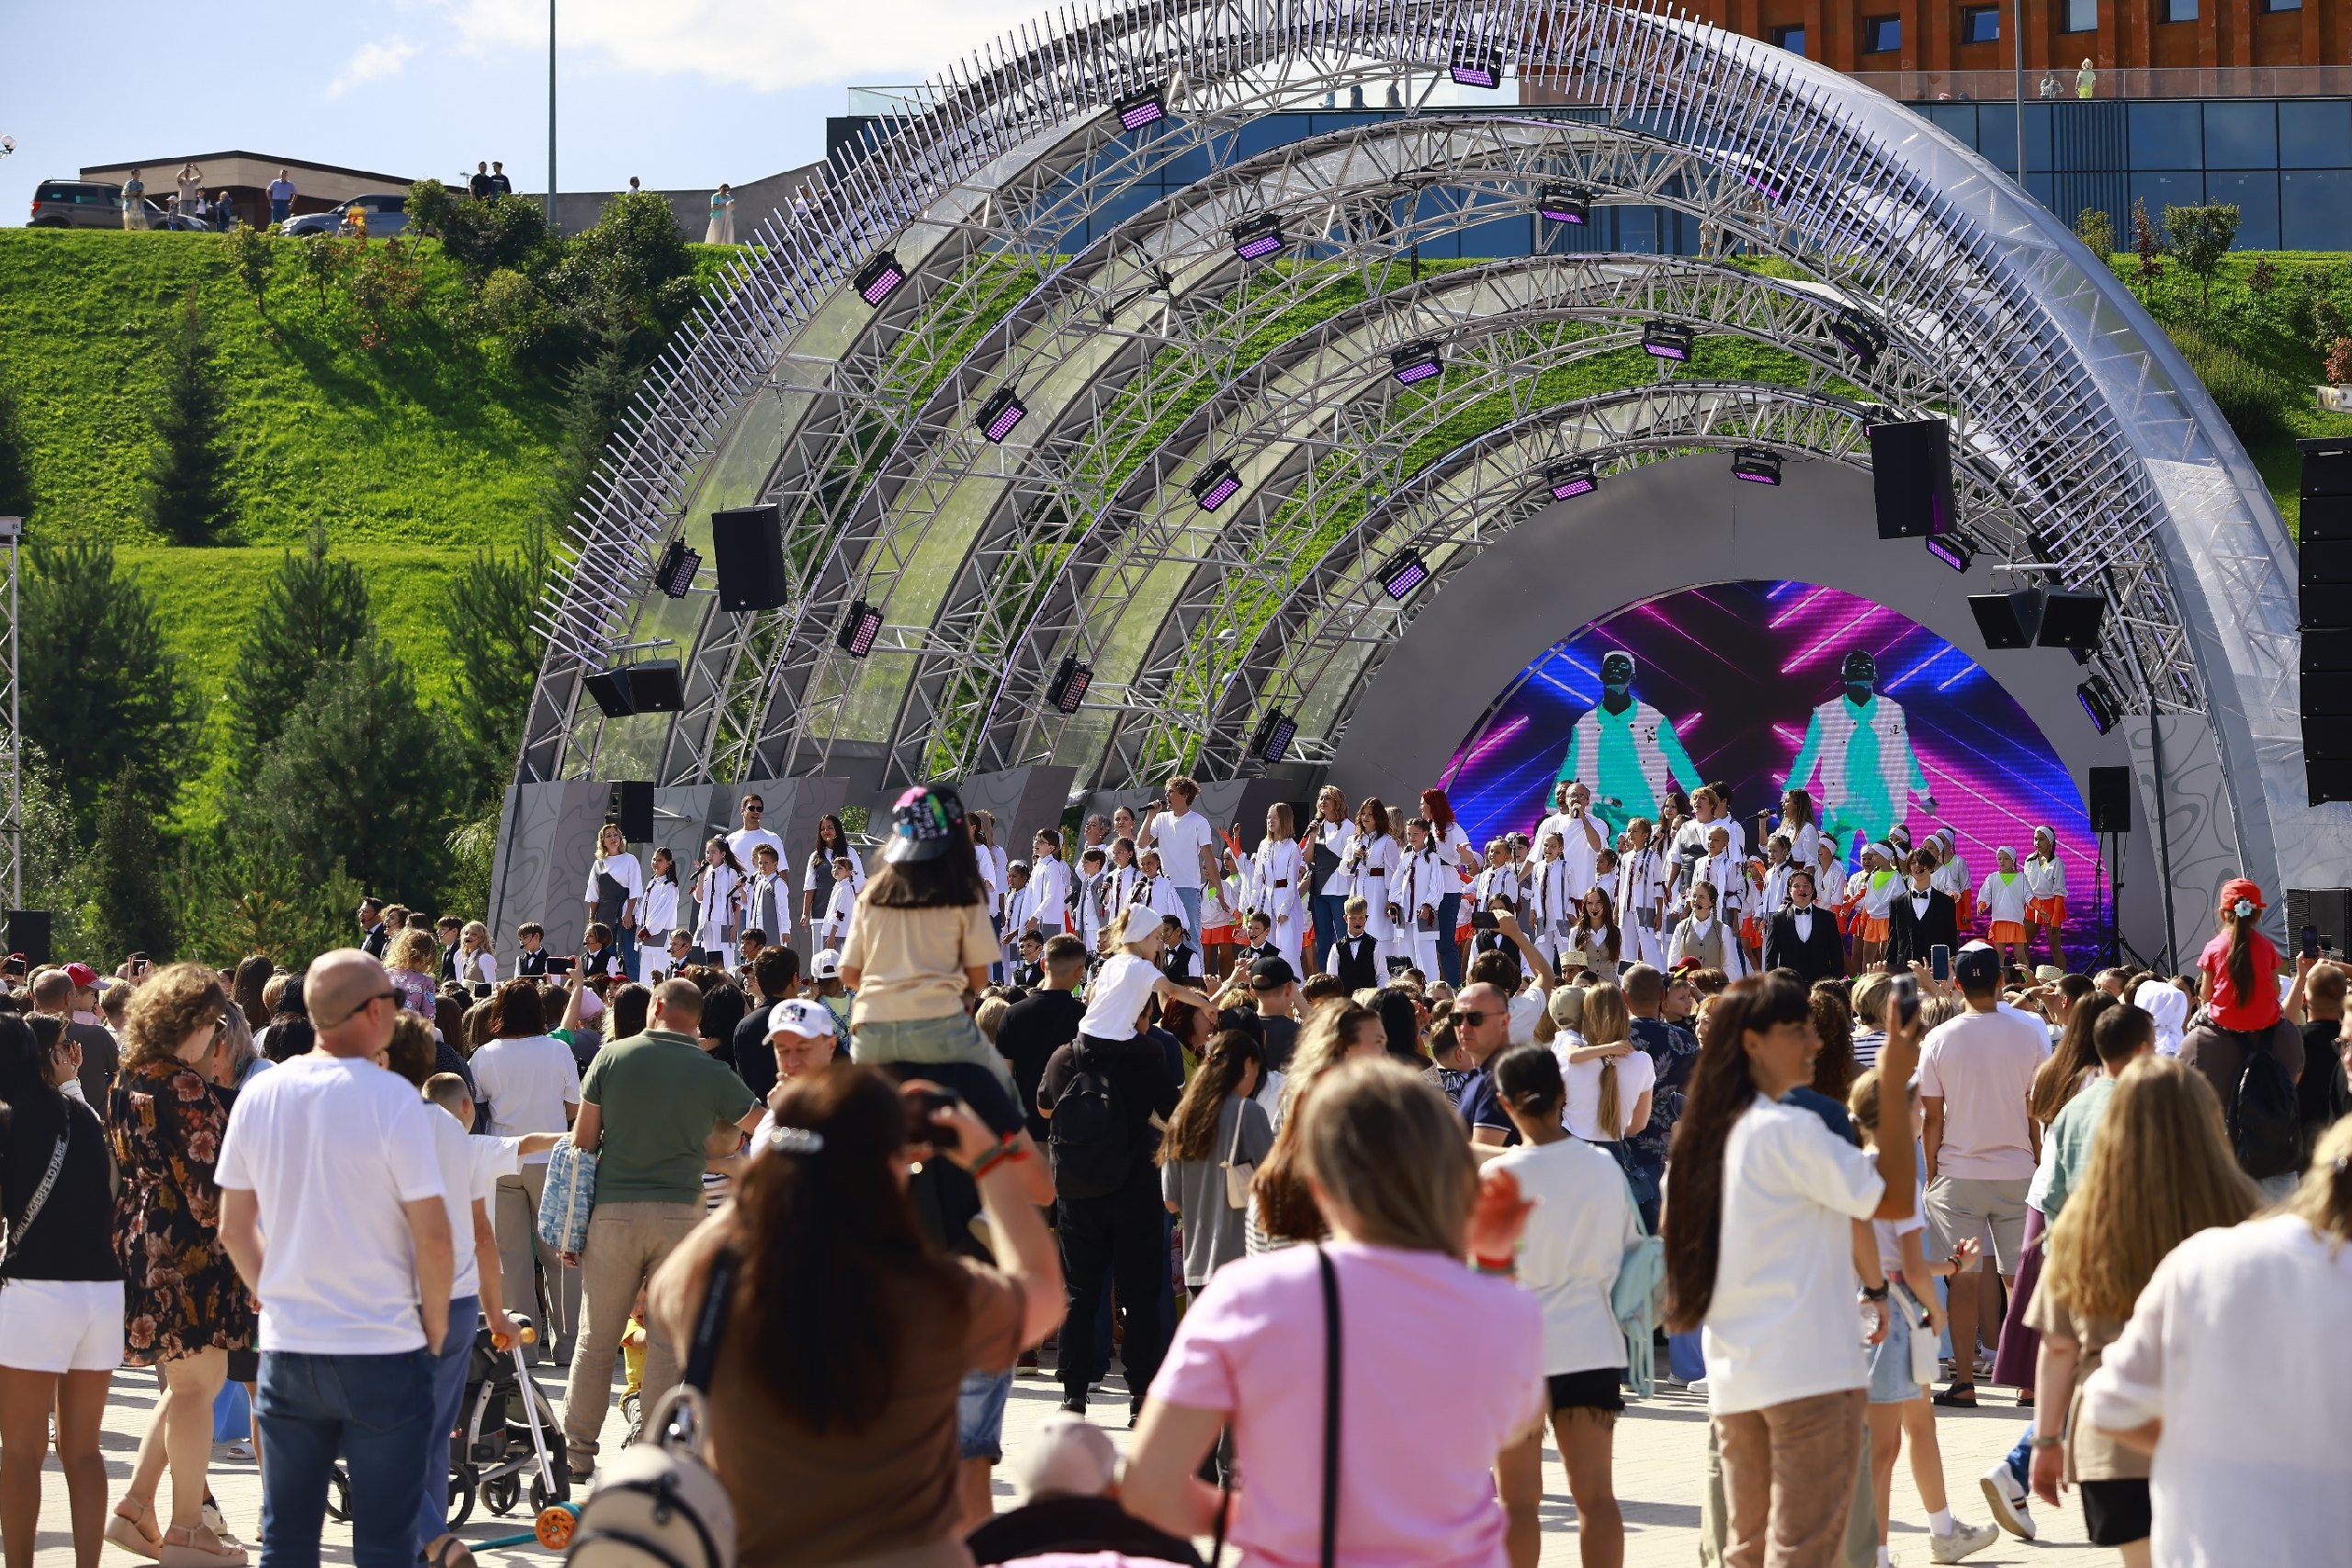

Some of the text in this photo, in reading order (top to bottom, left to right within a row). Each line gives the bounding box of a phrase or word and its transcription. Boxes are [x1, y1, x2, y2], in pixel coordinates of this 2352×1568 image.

[11, 1139, 66, 1246] KARL LAGERFELD PARIS
